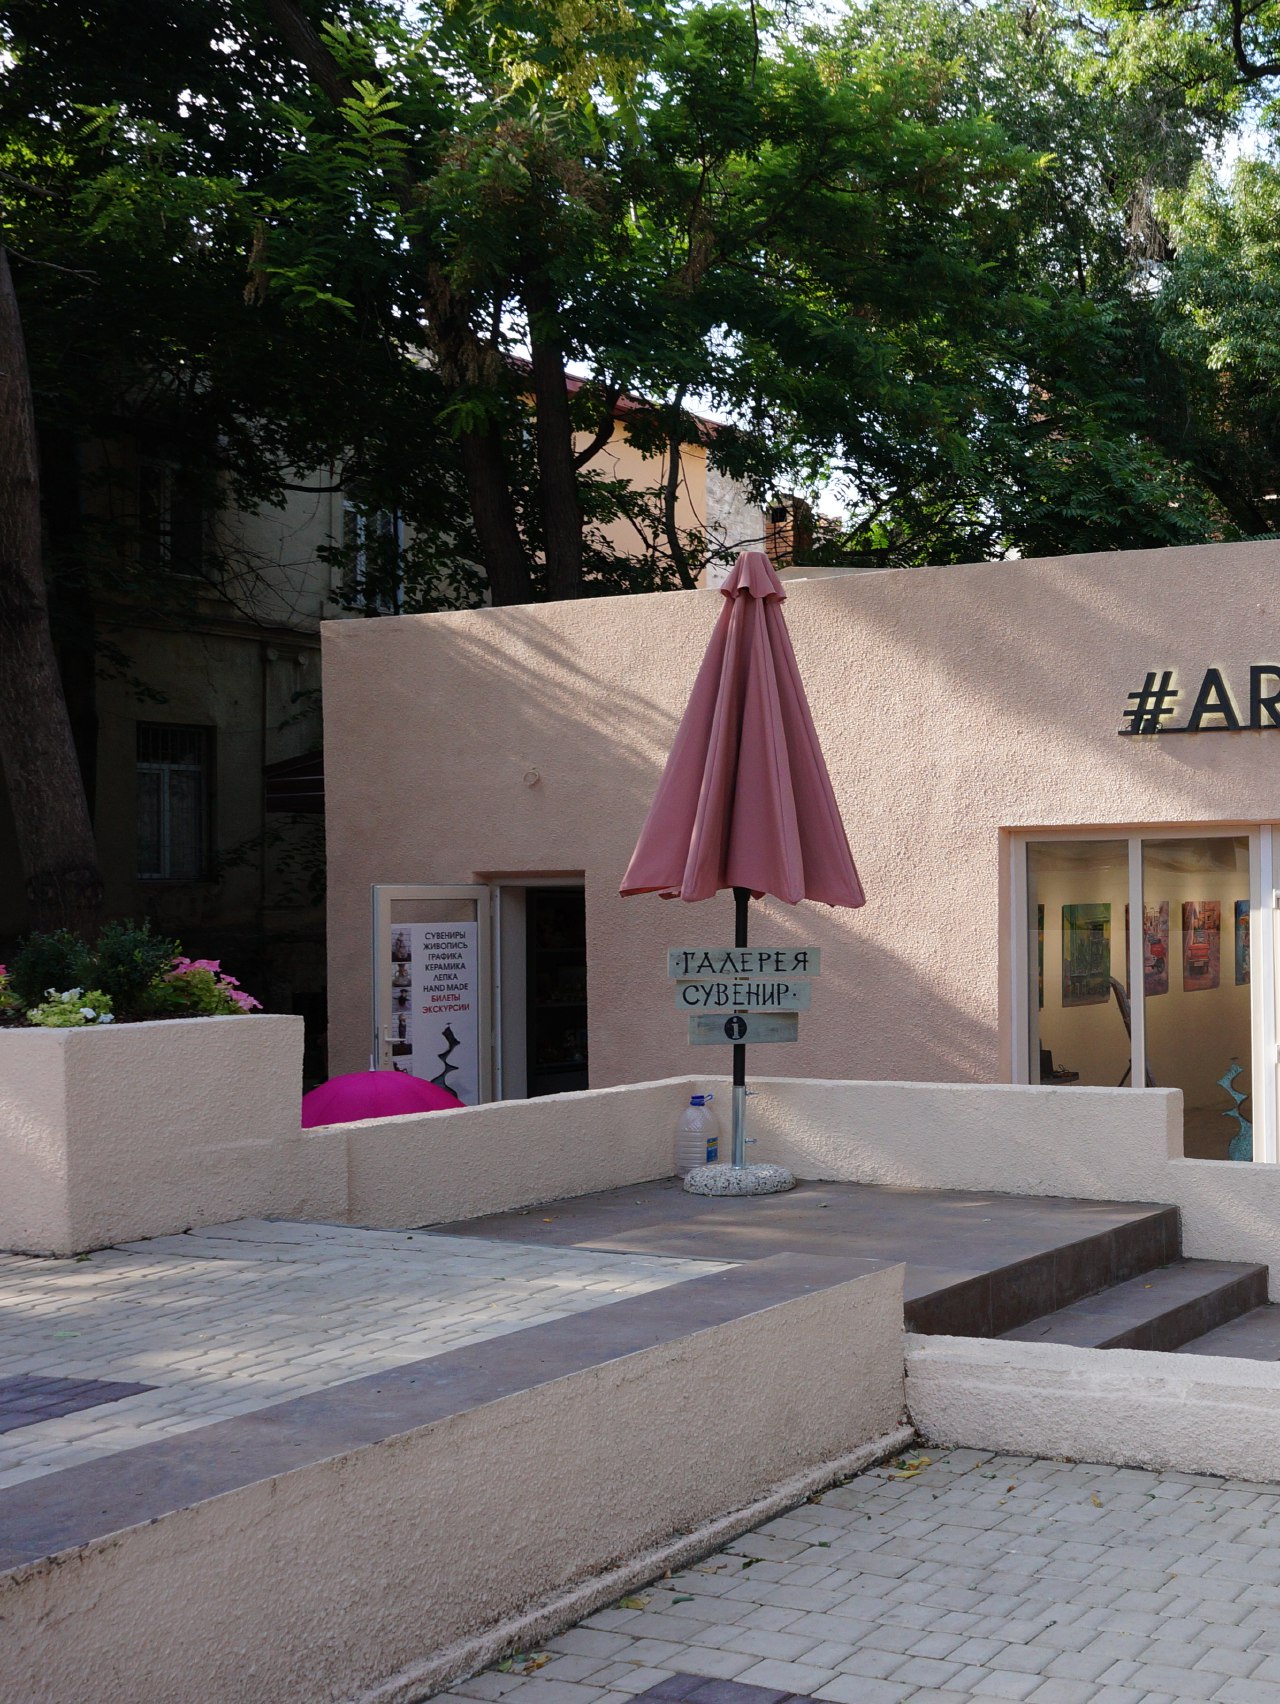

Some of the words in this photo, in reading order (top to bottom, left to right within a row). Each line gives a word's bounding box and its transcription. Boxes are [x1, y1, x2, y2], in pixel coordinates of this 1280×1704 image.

[424, 931, 466, 940] СУВЕНИРЫ
[423, 941, 468, 950] ЖИВОПИСЬ
[428, 952, 463, 961] ГРАФИКА
[425, 962, 466, 971] КЕРАМИКА
[682, 950, 809, 974] ГАЛЕРЕЯ
[433, 973, 459, 982] ЛЕПКА
[423, 984, 446, 993] HAND
[446, 983, 469, 992] MADE
[431, 993, 461, 1003] БИЛЕТЫ
[682, 982, 790, 1007] СУВЕНИР
[422, 1003, 470, 1014] ЭКСКУРСИИ
